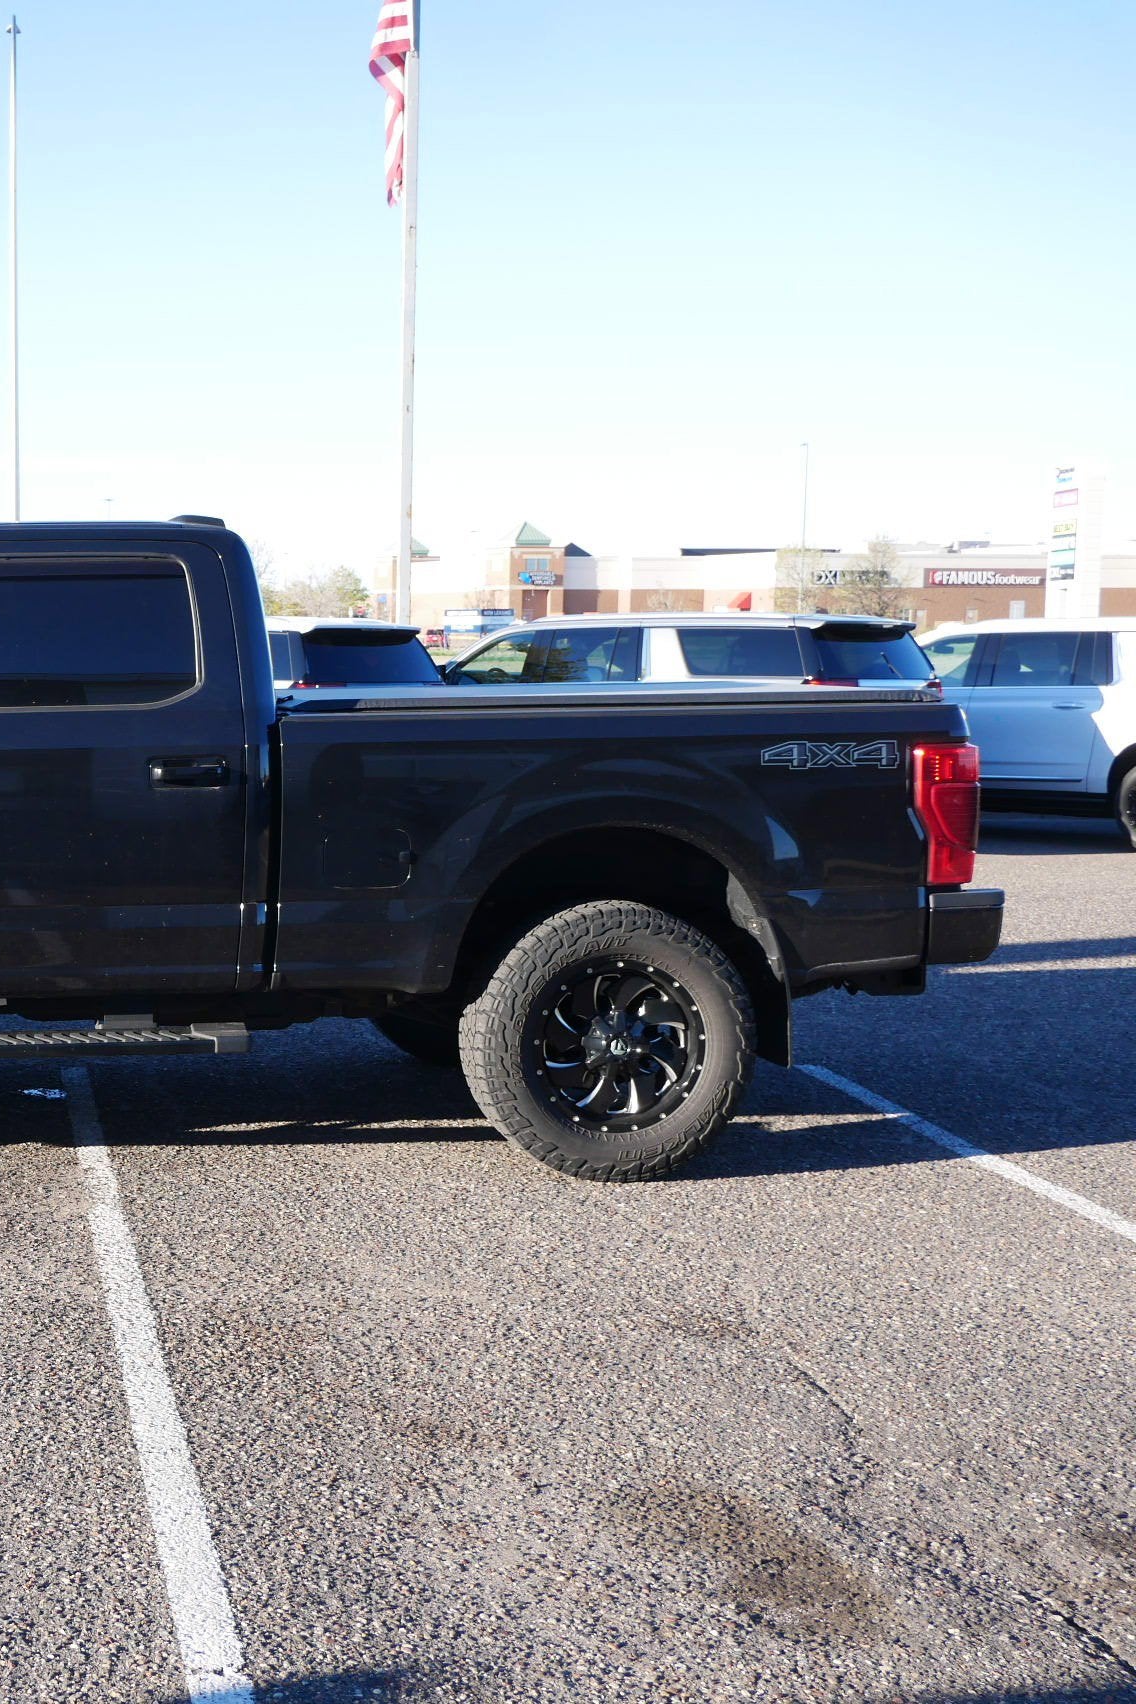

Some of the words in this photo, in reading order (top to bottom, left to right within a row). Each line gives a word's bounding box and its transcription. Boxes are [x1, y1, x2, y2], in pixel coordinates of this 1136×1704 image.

[942, 570, 995, 585] FAMOUS
[994, 573, 1042, 585] footwear
[618, 1080, 728, 1161] FALKEN
